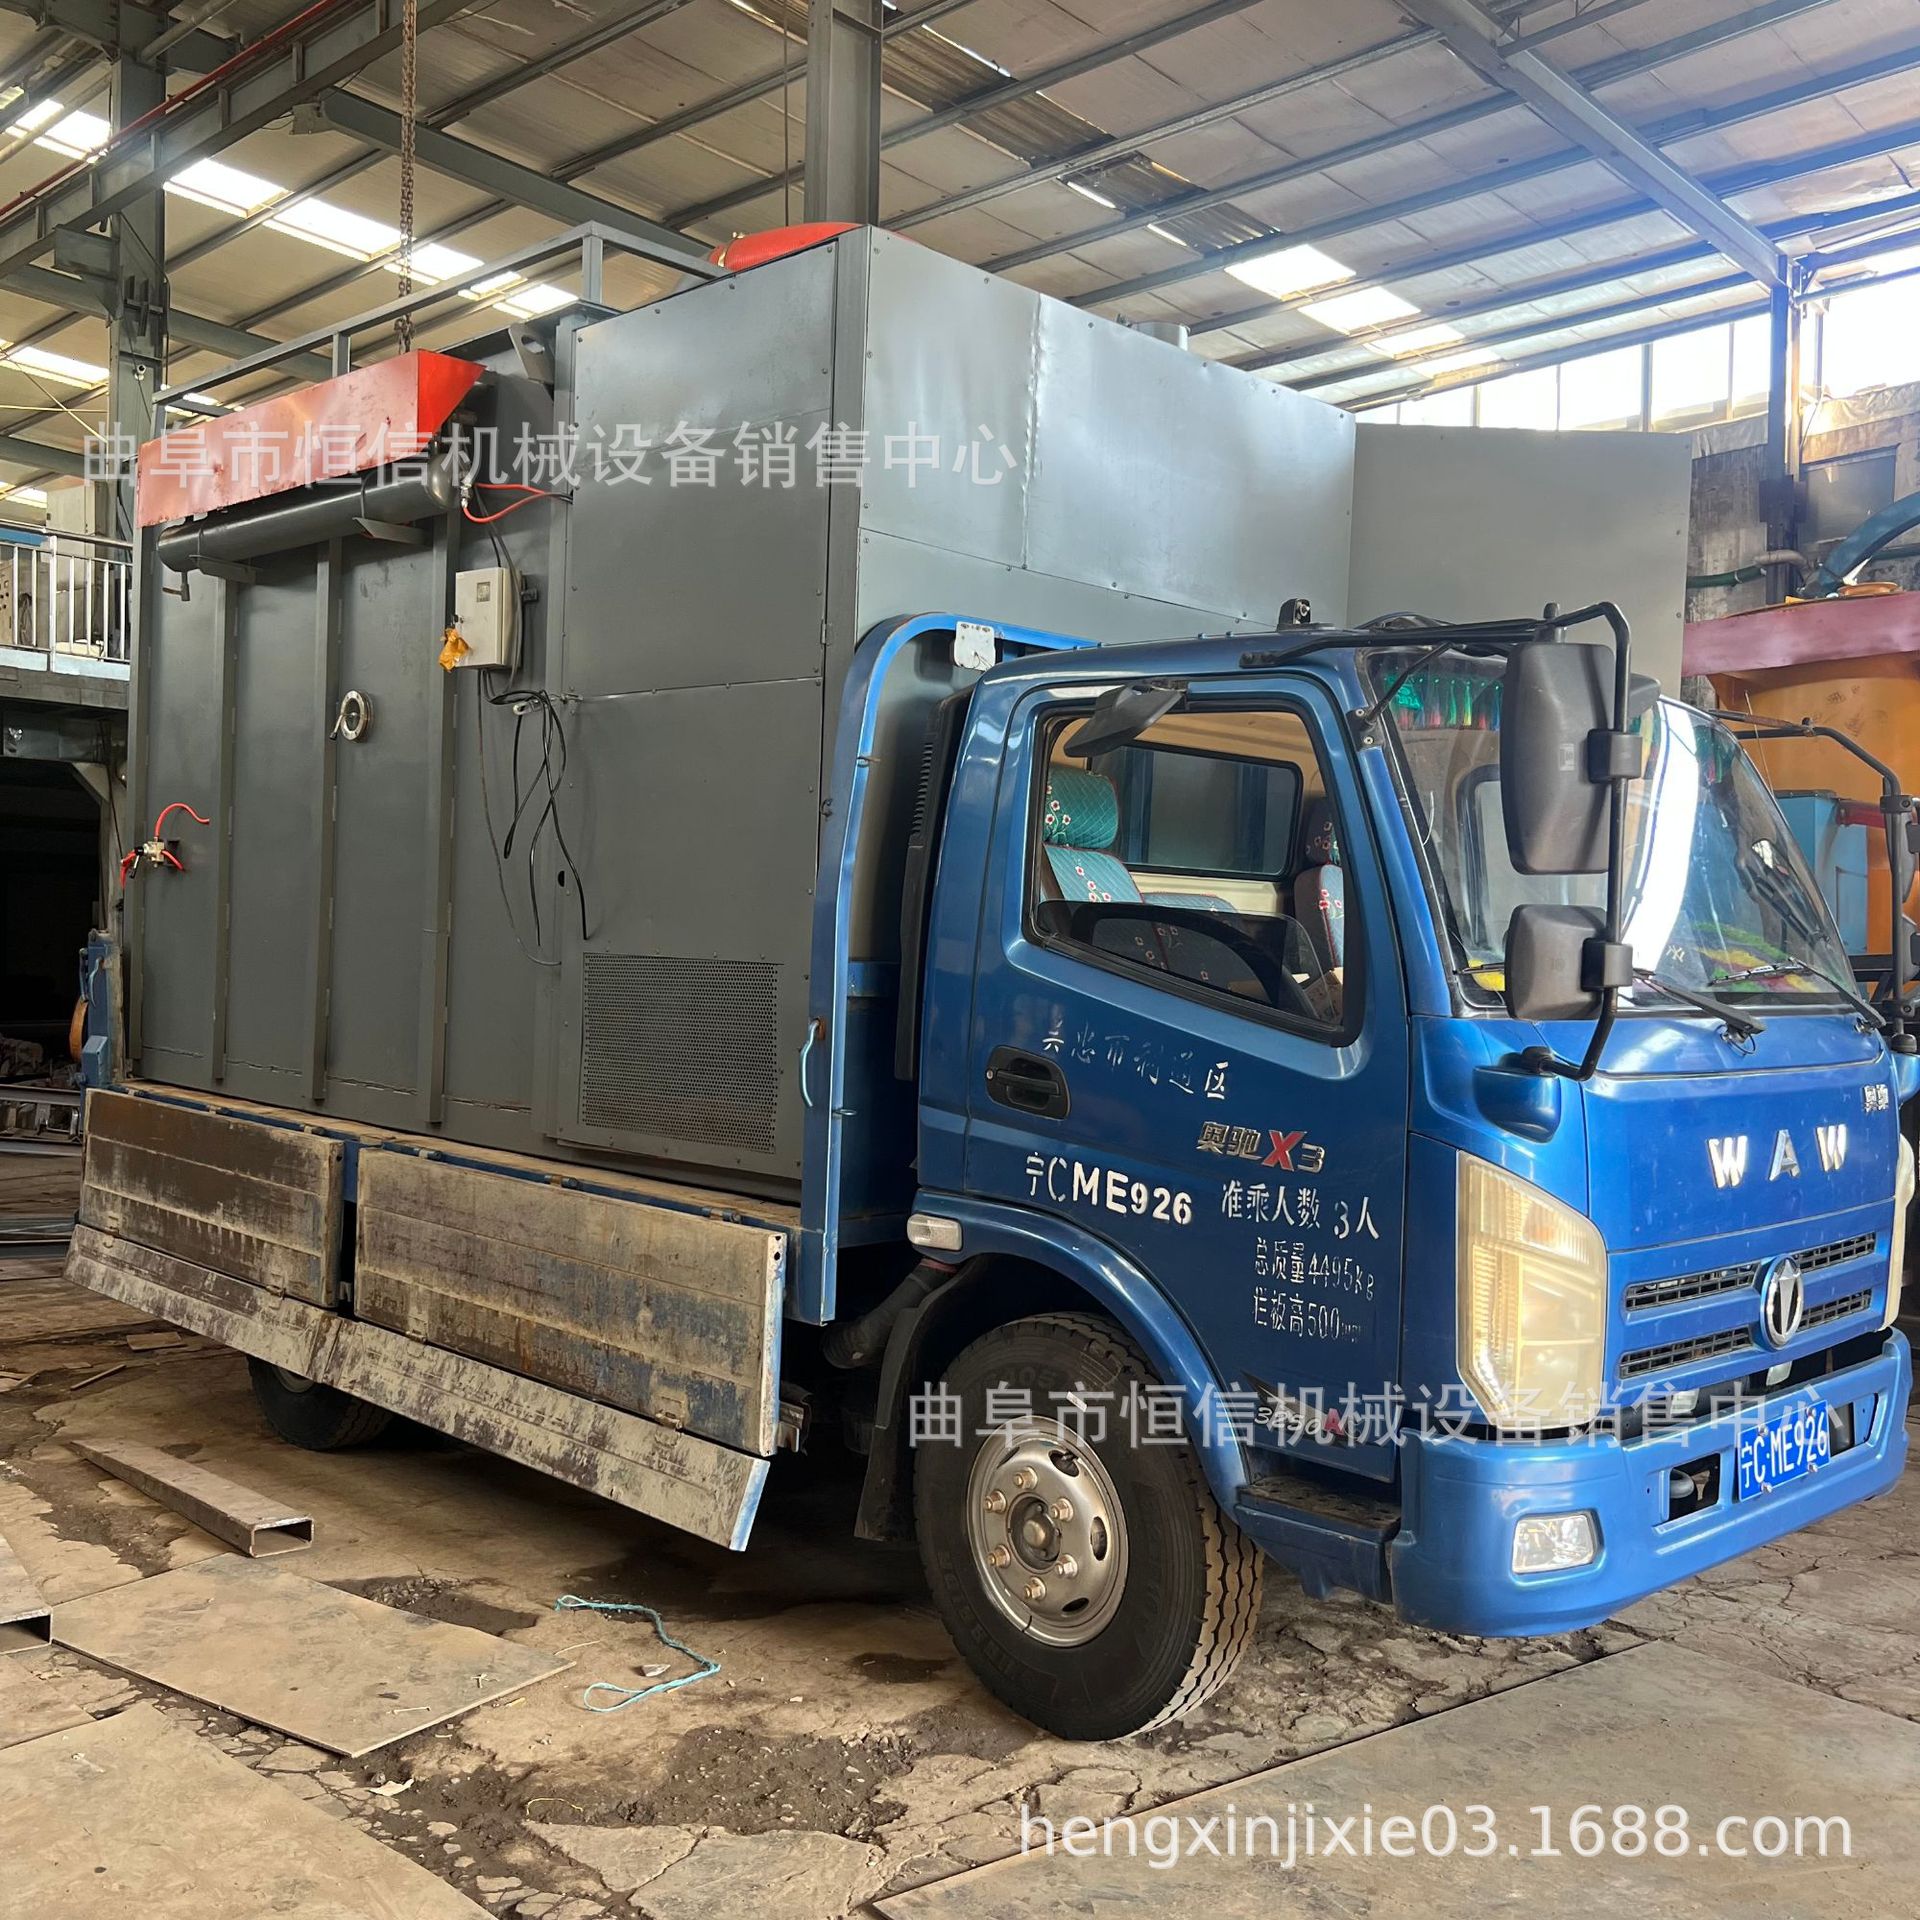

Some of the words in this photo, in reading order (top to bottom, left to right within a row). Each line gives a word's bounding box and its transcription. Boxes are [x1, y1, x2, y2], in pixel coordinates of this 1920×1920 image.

[1025, 1152, 1193, 1225] 宁CME926
[1705, 1124, 1847, 1189] WAW
[1221, 1180, 1321, 1229] 准乘人数
[1333, 1196, 1381, 1240] 3人
